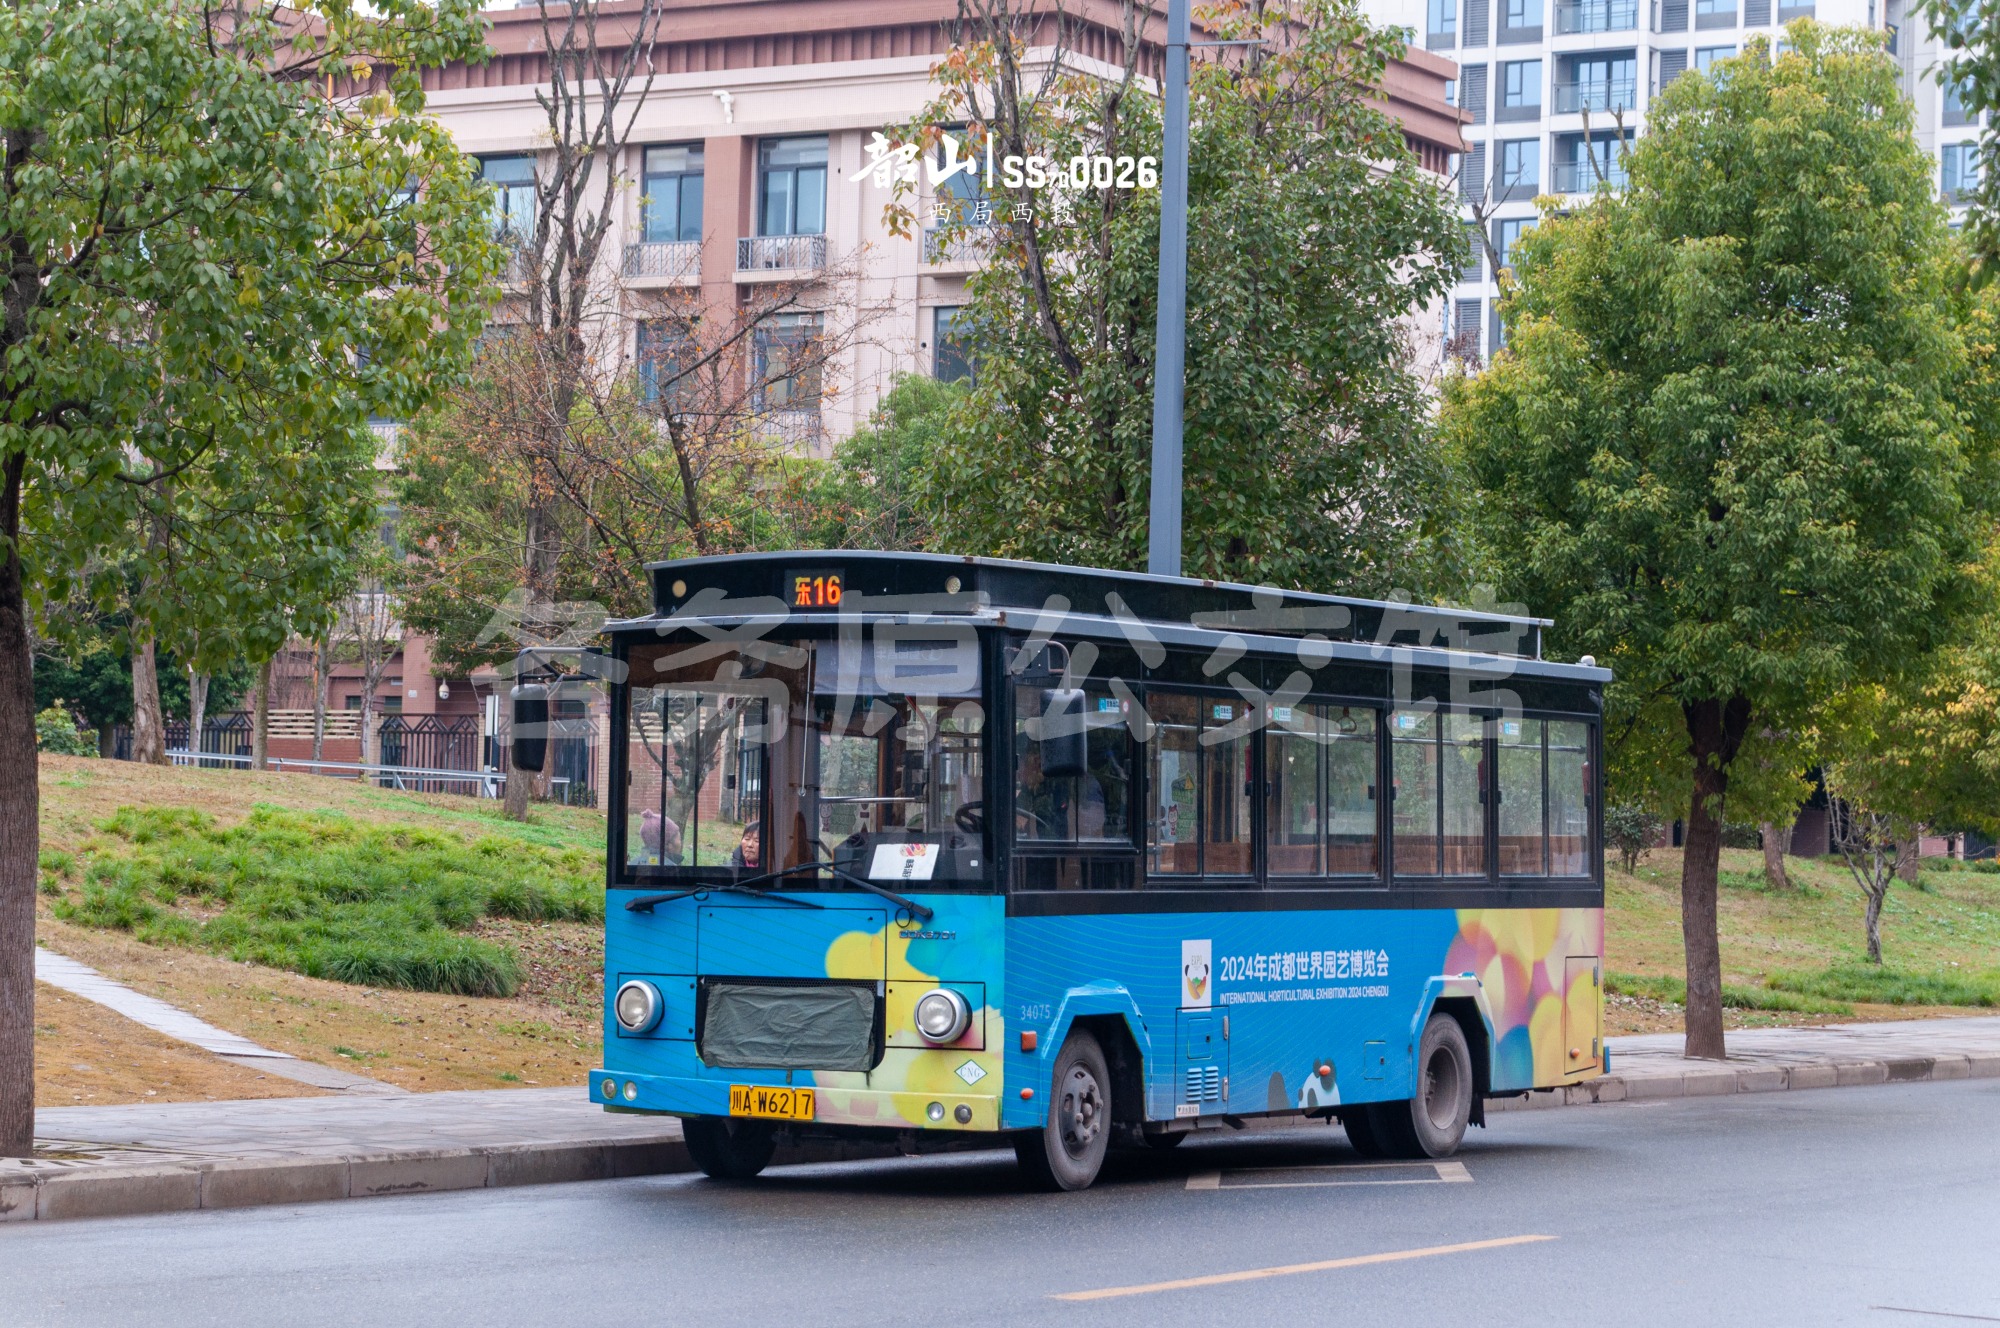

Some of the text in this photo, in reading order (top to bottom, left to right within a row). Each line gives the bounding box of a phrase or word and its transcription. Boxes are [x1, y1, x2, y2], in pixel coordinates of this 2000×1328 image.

[795, 575, 841, 606] 东16
[1220, 948, 1390, 982] 2024年成都世界园艺博览会
[1220, 985, 1389, 1005] INTERNATIONAL HORTICULTURAL EXHIBITION 2024 CHENGDU
[1020, 1004, 1051, 1020] 34075
[960, 1066, 981, 1078] CNG
